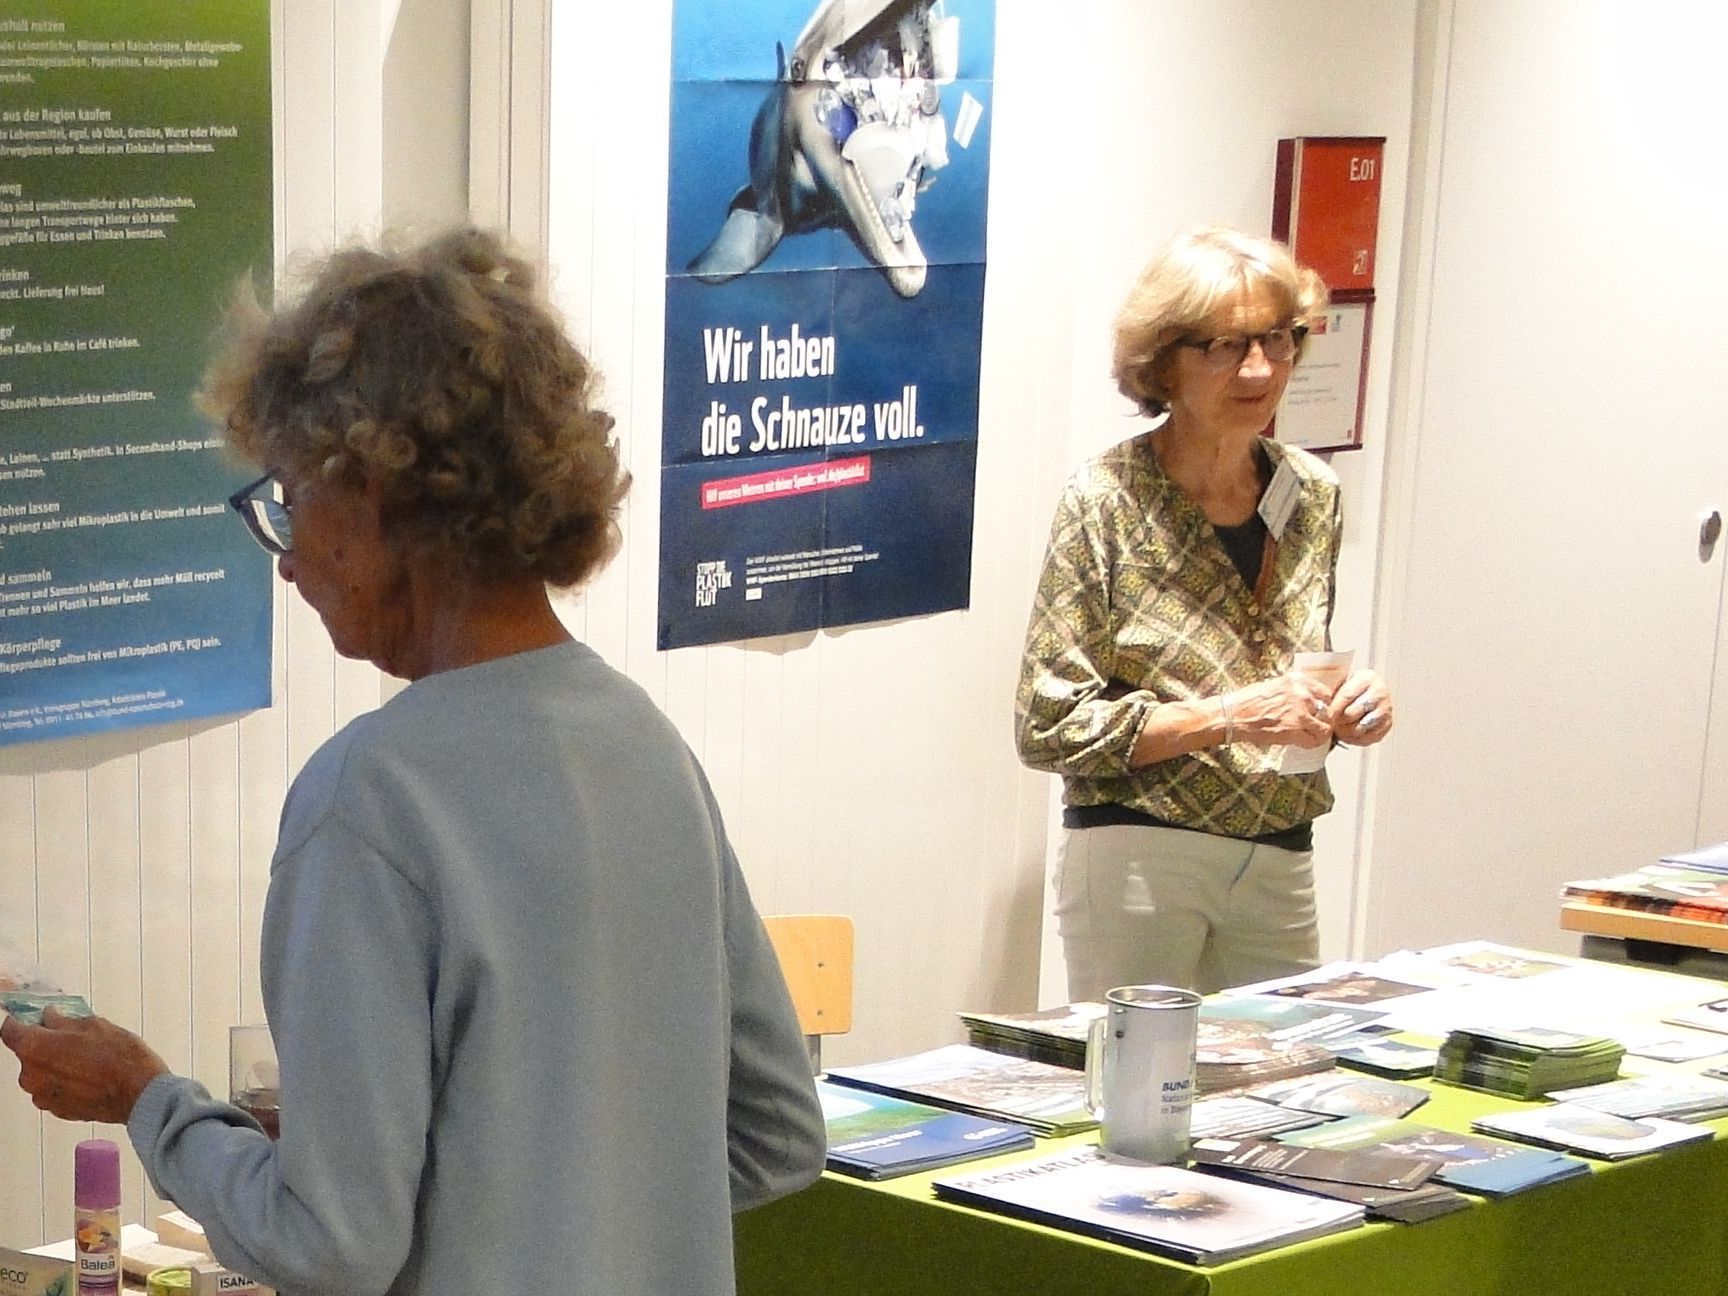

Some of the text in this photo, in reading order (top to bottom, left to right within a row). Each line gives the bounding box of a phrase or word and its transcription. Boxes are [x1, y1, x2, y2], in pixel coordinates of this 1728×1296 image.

[1350, 157, 1375, 181] E.01
[703, 324, 835, 383] Wir haben
[701, 385, 924, 456] die Schnauze voll.
[29, 503, 61, 514] lassen
[8, 569, 52, 585] sammeln
[696, 571, 732, 591] PLASTIK
[695, 588, 717, 607] FLUT
[0, 638, 61, 656] Körperpflege
[81, 1258, 115, 1271] Balea
